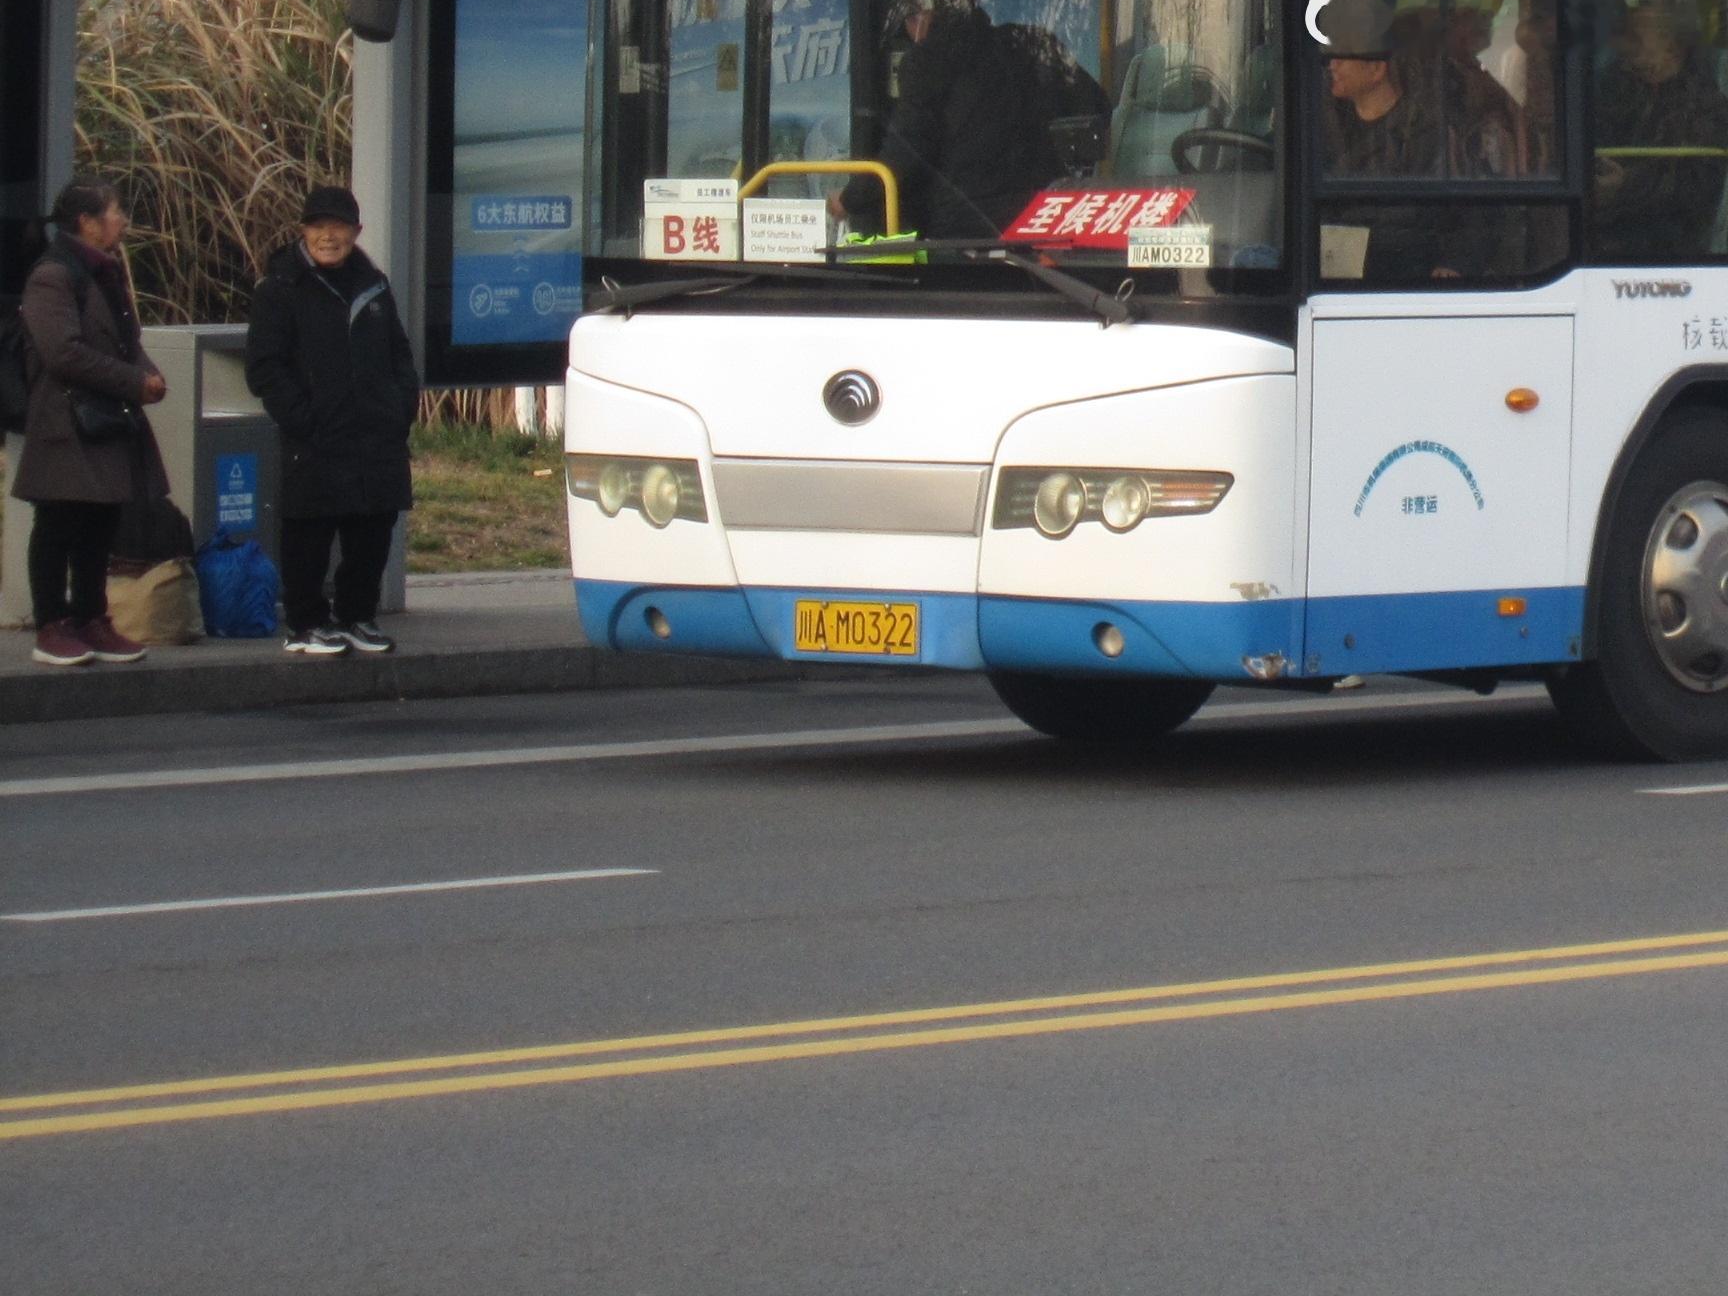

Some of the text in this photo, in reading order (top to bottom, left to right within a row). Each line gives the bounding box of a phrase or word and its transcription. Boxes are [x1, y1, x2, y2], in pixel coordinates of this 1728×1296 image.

[477, 202, 565, 225] 6大东航权益
[1016, 191, 1177, 235] 至候机楼
[663, 215, 721, 254] B线
[751, 244, 766, 253] Only
[778, 244, 800, 254] Airport
[1132, 247, 1205, 263] 川AM0322
[1612, 280, 1692, 298] YUTONG
